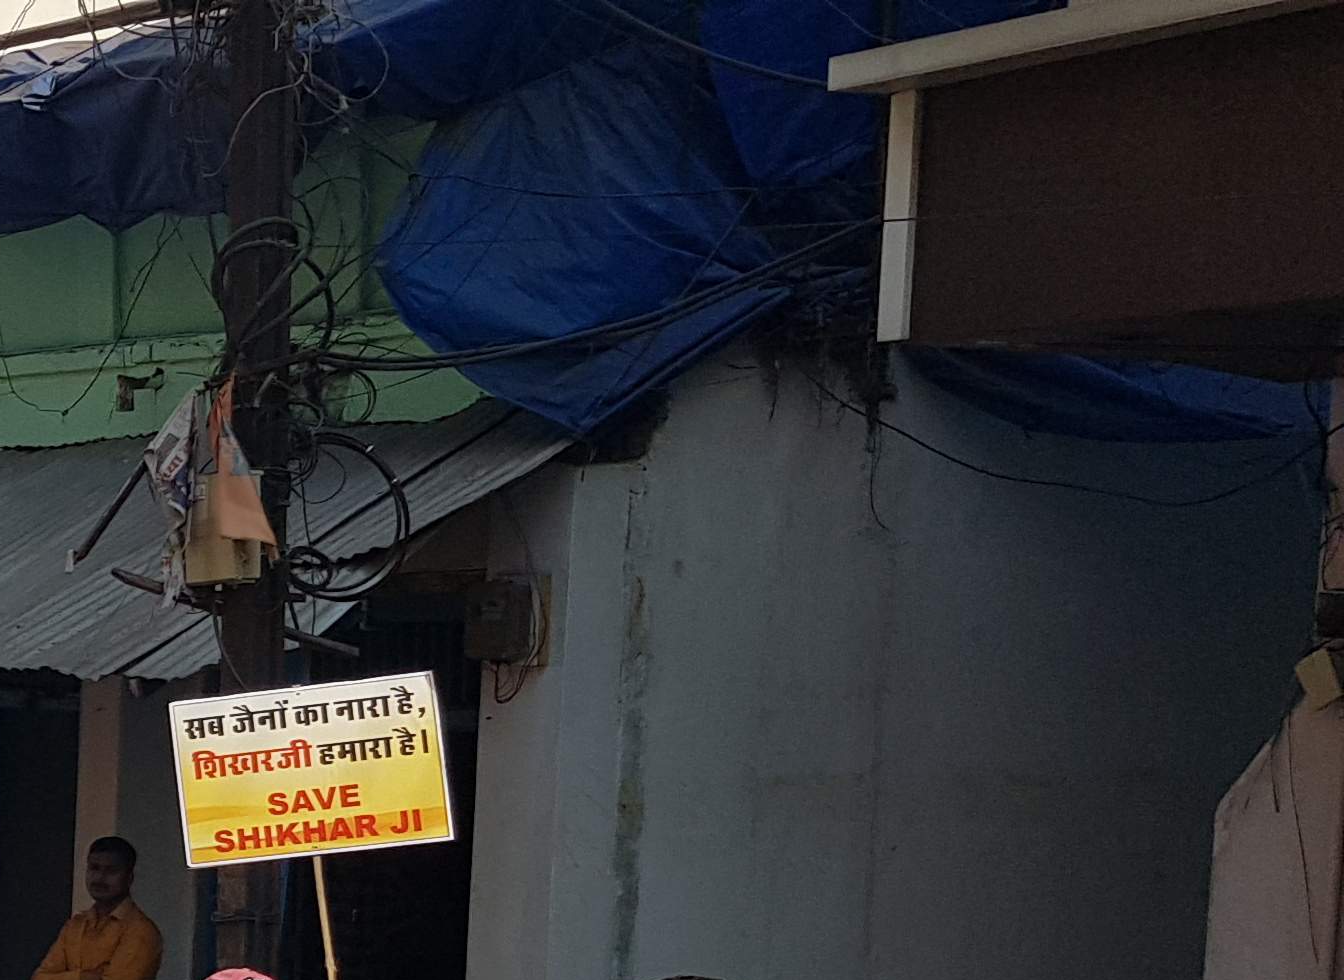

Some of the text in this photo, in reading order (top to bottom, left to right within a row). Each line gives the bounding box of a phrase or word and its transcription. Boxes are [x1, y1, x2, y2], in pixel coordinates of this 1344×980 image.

[183, 714, 227, 740] सब
[229, 699, 289, 733] जैनों
[292, 702, 330, 727] का
[334, 694, 391, 721] नारा
[191, 738, 312, 781] शिखरजी
[316, 735, 393, 766] हमारा
[267, 784, 362, 816] SAVE
[214, 808, 424, 854] SHIKHAR JI
